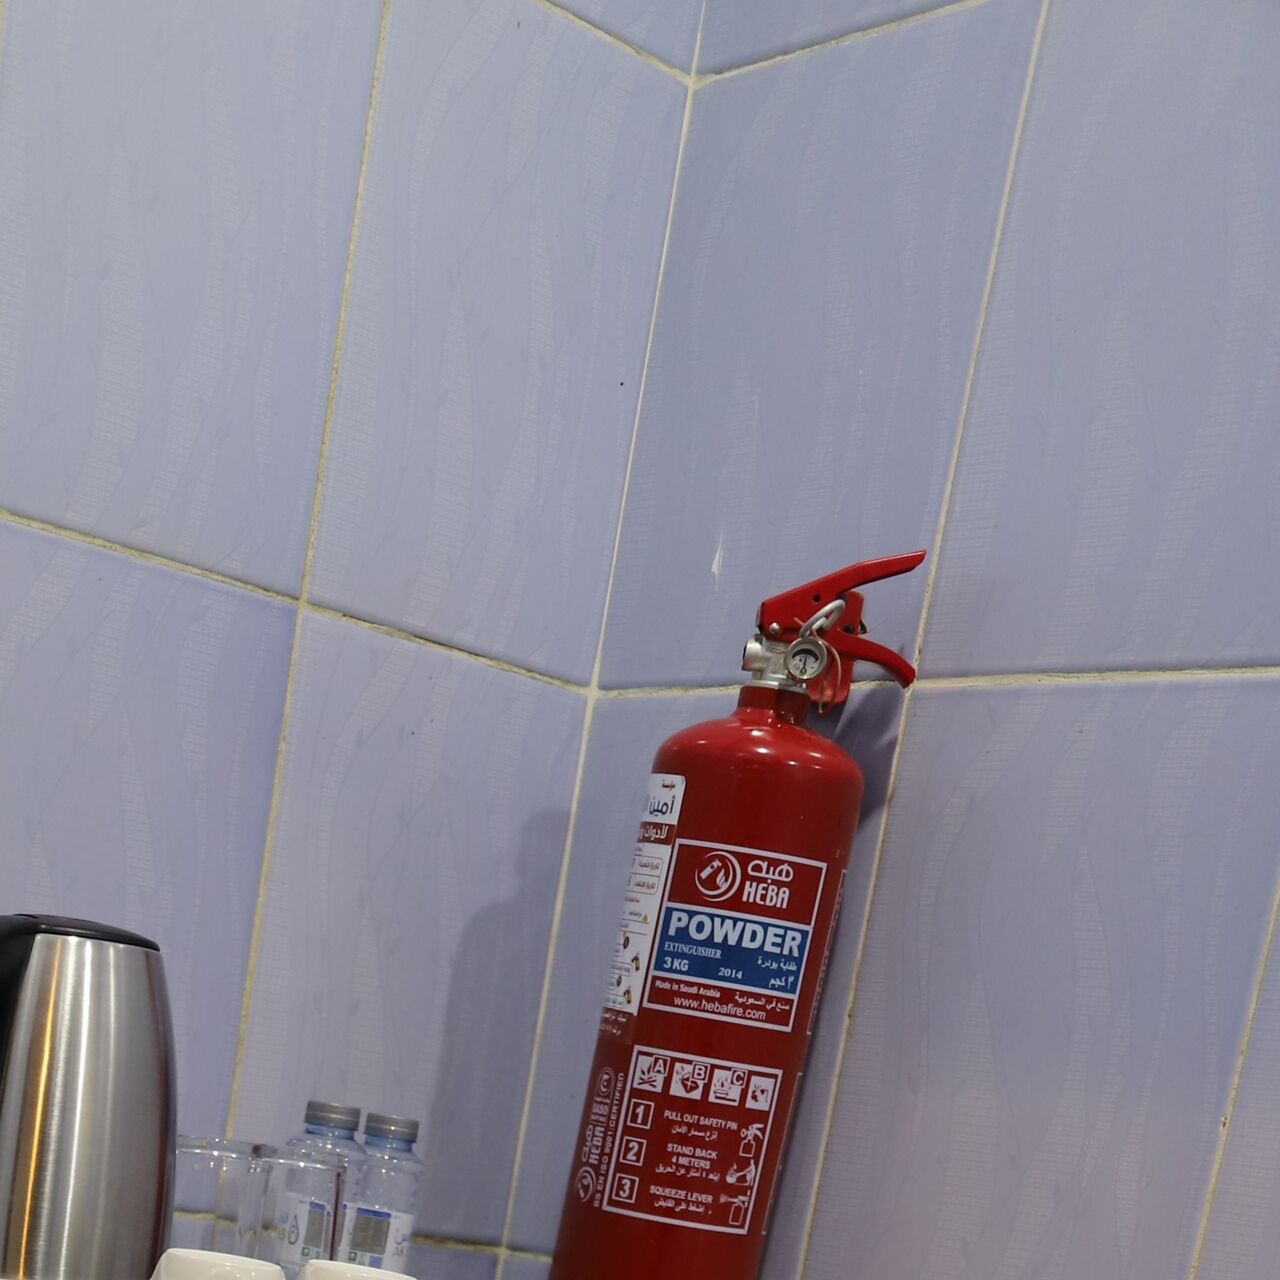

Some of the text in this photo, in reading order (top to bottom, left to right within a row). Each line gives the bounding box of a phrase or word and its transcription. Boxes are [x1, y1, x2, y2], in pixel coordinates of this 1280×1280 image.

[742, 880, 790, 909] HEBA
[668, 911, 802, 957] POWDER
[664, 940, 722, 960] EXTINGUISHER
[663, 956, 689, 972] 3 KG
[718, 967, 743, 979] 2014
[655, 979, 721, 998] Made in Saudi Arabia
[673, 996, 766, 1020] www.hebafire.com
[653, 1059, 665, 1074] A
[694, 1066, 706, 1080] B
[732, 1071, 744, 1085] C
[635, 1105, 644, 1124] 1
[663, 1109, 738, 1131] PULL OUT SAFETY PIN
[628, 1141, 638, 1161] 2
[666, 1143, 718, 1160] STAND BACK
[678, 1156, 711, 1170] METERS
[619, 1180, 630, 1198] 3
[649, 1185, 713, 1203] SQUEEZE LEVER
